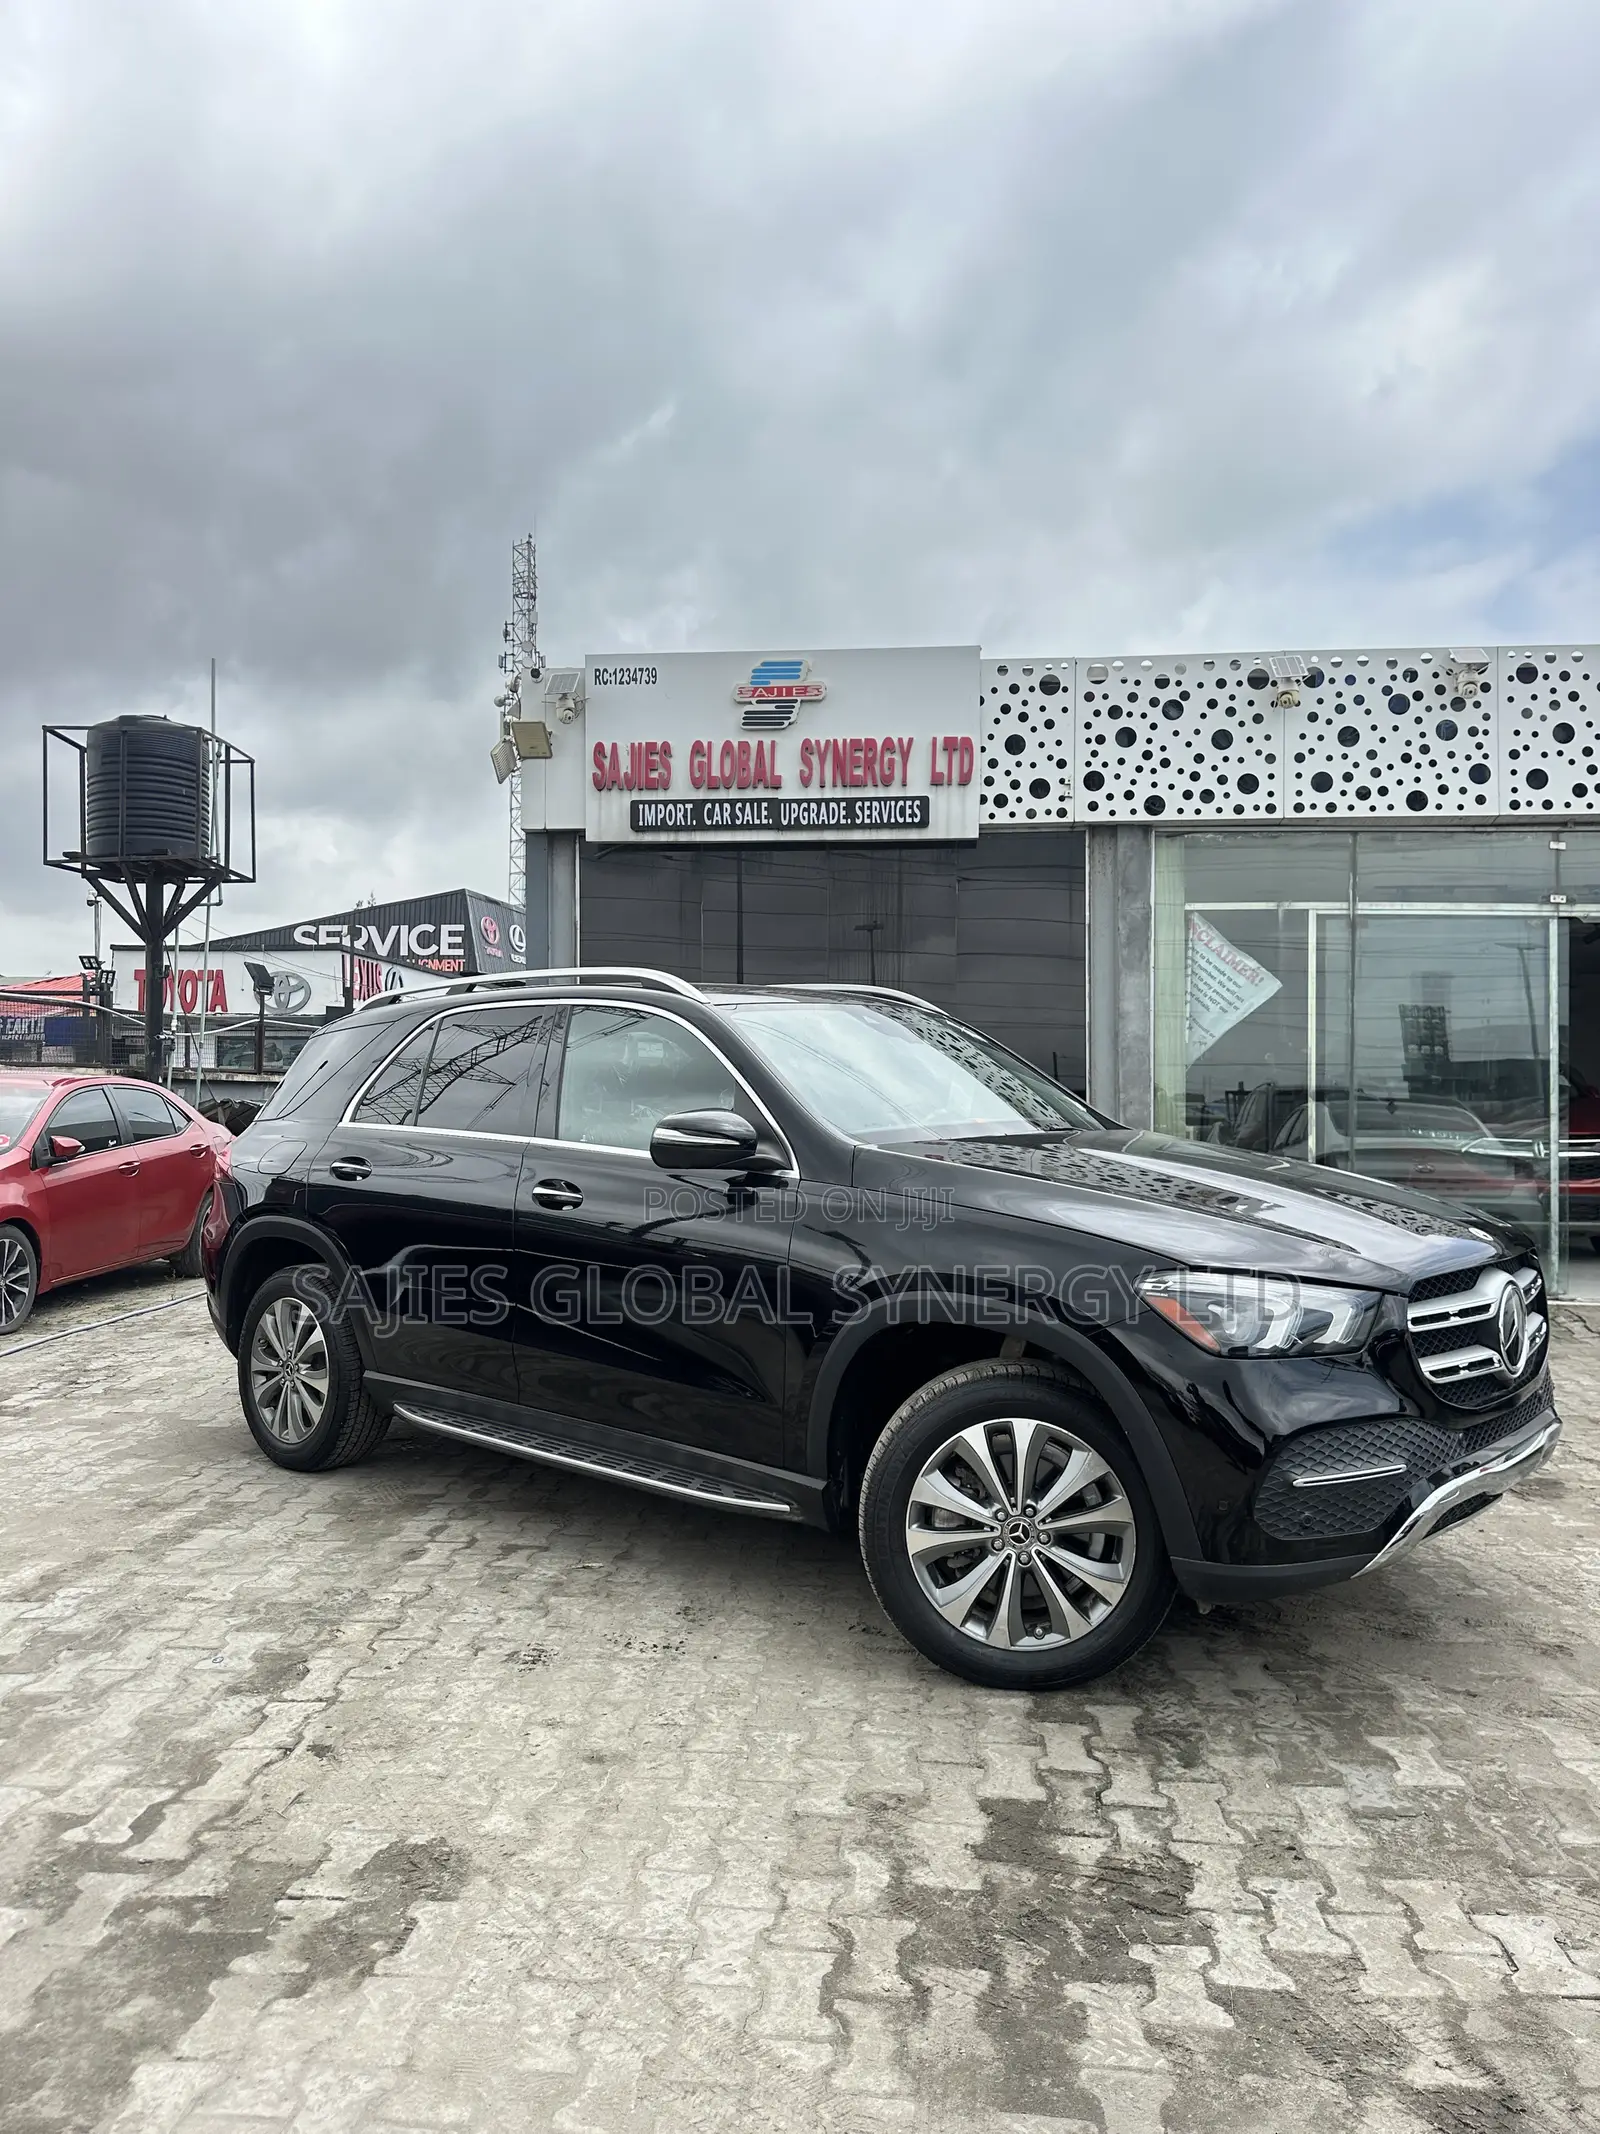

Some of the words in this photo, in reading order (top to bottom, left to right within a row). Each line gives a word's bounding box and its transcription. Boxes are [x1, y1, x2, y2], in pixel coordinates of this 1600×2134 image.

[594, 667, 657, 685] RC:1234739
[738, 684, 824, 698] SAJIES
[592, 741, 673, 791] SAJIES
[689, 740, 782, 790] GLOBAL
[799, 736, 914, 788] SYNERGY
[930, 736, 974, 786] LTD
[638, 802, 696, 826] IMPORT.
[703, 802, 732, 825] CAR
[735, 801, 773, 825] SALE.
[780, 801, 851, 826] UPGRADE.
[855, 800, 921, 824] SERVICES
[293, 923, 465, 956] SERVICE
[134, 969, 228, 1013] TYOTA
